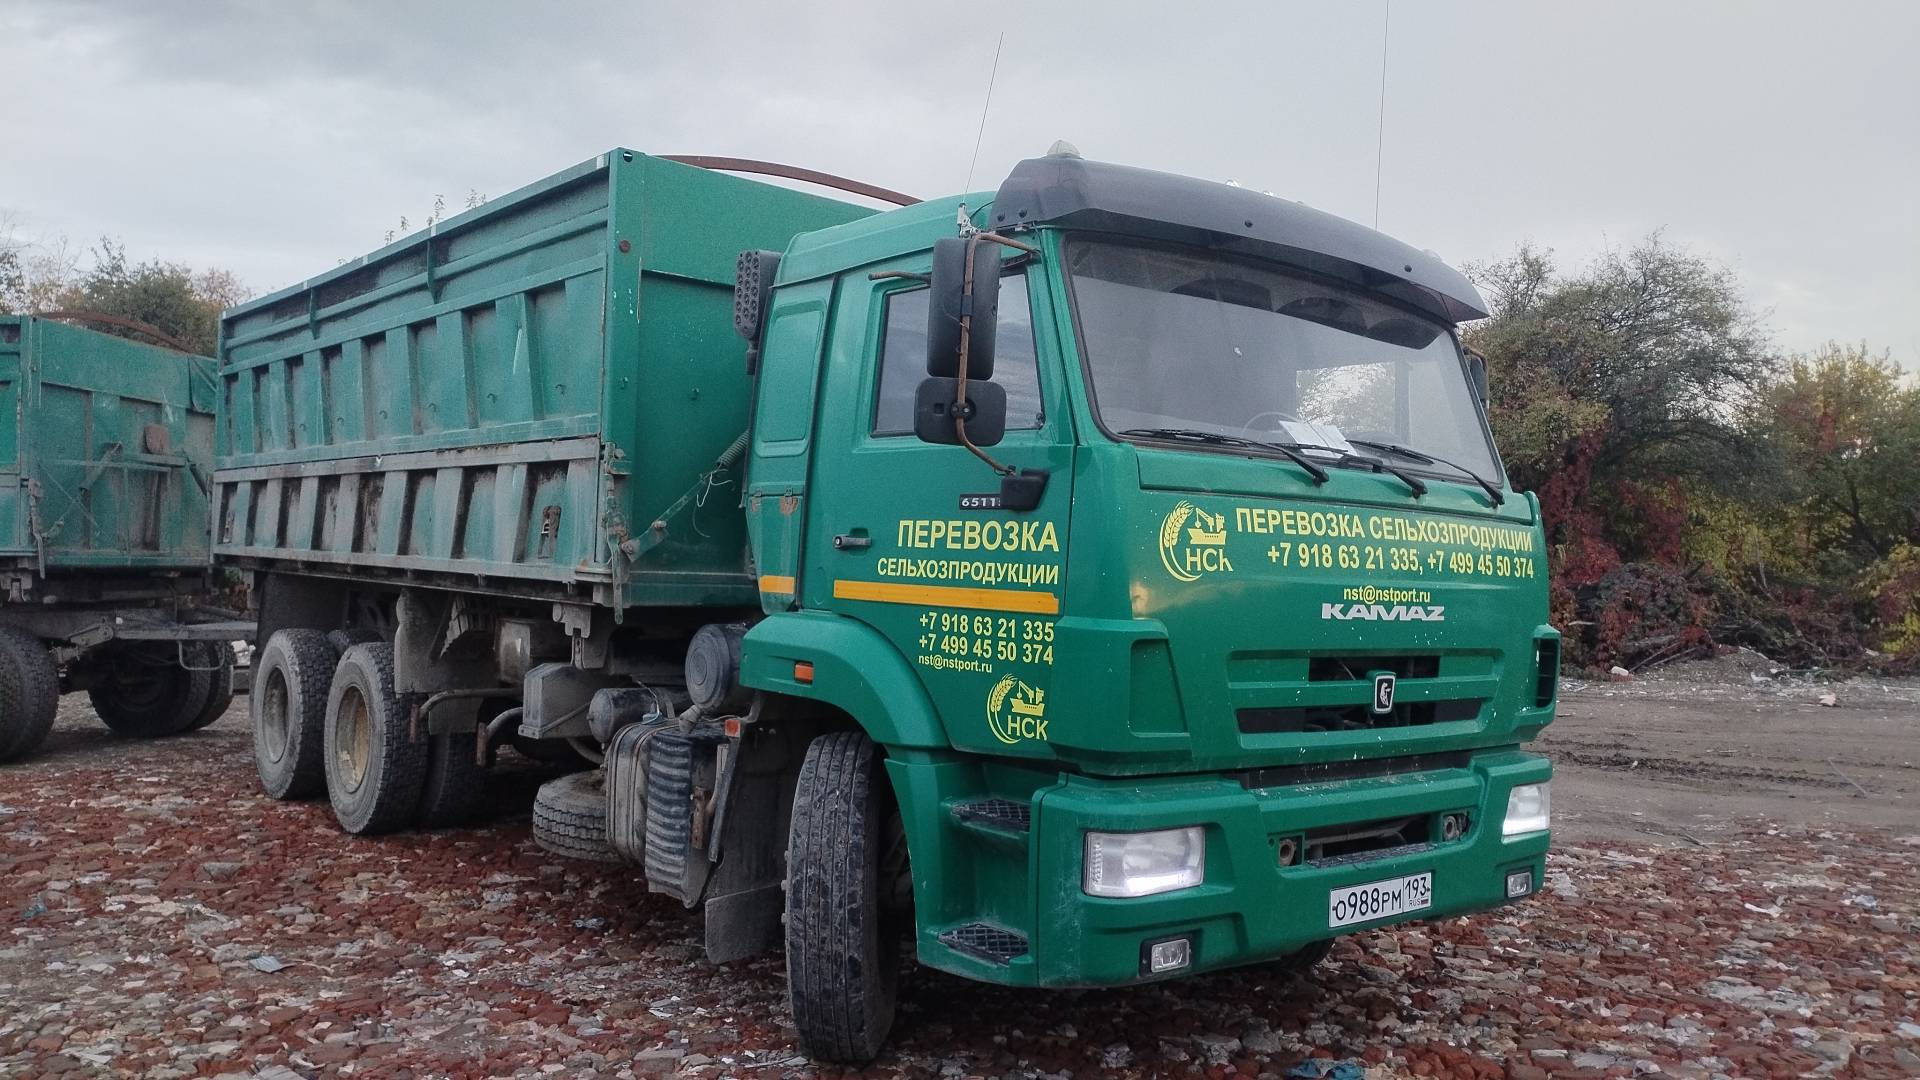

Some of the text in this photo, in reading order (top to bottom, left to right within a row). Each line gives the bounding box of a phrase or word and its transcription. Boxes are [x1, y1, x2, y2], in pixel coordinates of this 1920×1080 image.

[961, 497, 1000, 507] 6511
[898, 520, 1059, 552] ПЕРЕВОЗКА
[1236, 507, 1533, 553] ПЕРЕВОЗКА СЕЛЬХОЗПРОДУКЦИИ
[877, 558, 1059, 587] СЕЛЬХОЗПРОДУКЦИИ
[1267, 542, 1534, 578] +7 918 63 21 335, +7 499 45 50 374
[1343, 585, 1431, 605] nst@nstport.ru
[1321, 603, 1445, 621] KAMAZ
[919, 612, 1055, 642] +7 918 63 21 335
[919, 633, 1054, 665] +7 499 45 50 374
[918, 654, 993, 673] nst@nstport.ru
[1007, 715, 1049, 741] НСК
[1405, 876, 1427, 899] 193
[1408, 899, 1421, 907] RUS
